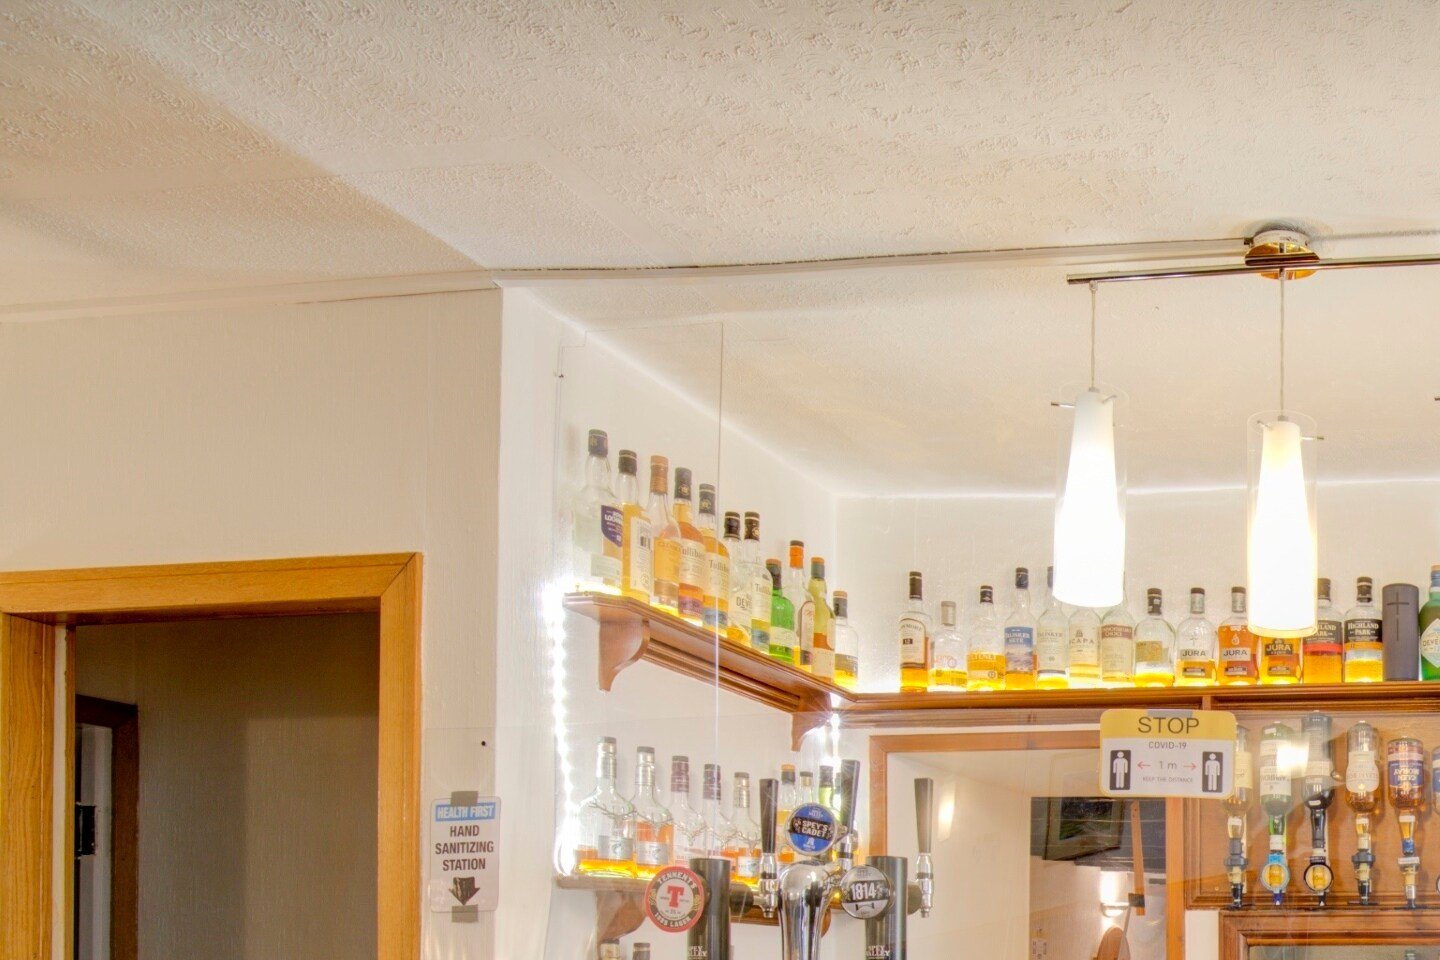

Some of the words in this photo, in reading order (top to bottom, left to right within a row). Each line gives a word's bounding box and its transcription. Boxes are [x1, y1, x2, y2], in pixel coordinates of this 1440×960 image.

[1348, 622, 1379, 630] HIGHLAND
[1266, 644, 1292, 652] JURA
[1138, 716, 1200, 735] STOP
[1148, 742, 1187, 750] COVID-19
[1159, 761, 1164, 770] 1
[1168, 762, 1178, 770] m
[438, 806, 468, 819] HEALTH
[470, 806, 494, 818] FIRST
[450, 825, 480, 837] HAND
[802, 820, 828, 832] SPEY'S
[802, 827, 826, 837] CADET
[435, 842, 494, 855] SANITIZING
[442, 858, 486, 871] STATION
[667, 885, 685, 908] T
[850, 882, 877, 901] 1814
